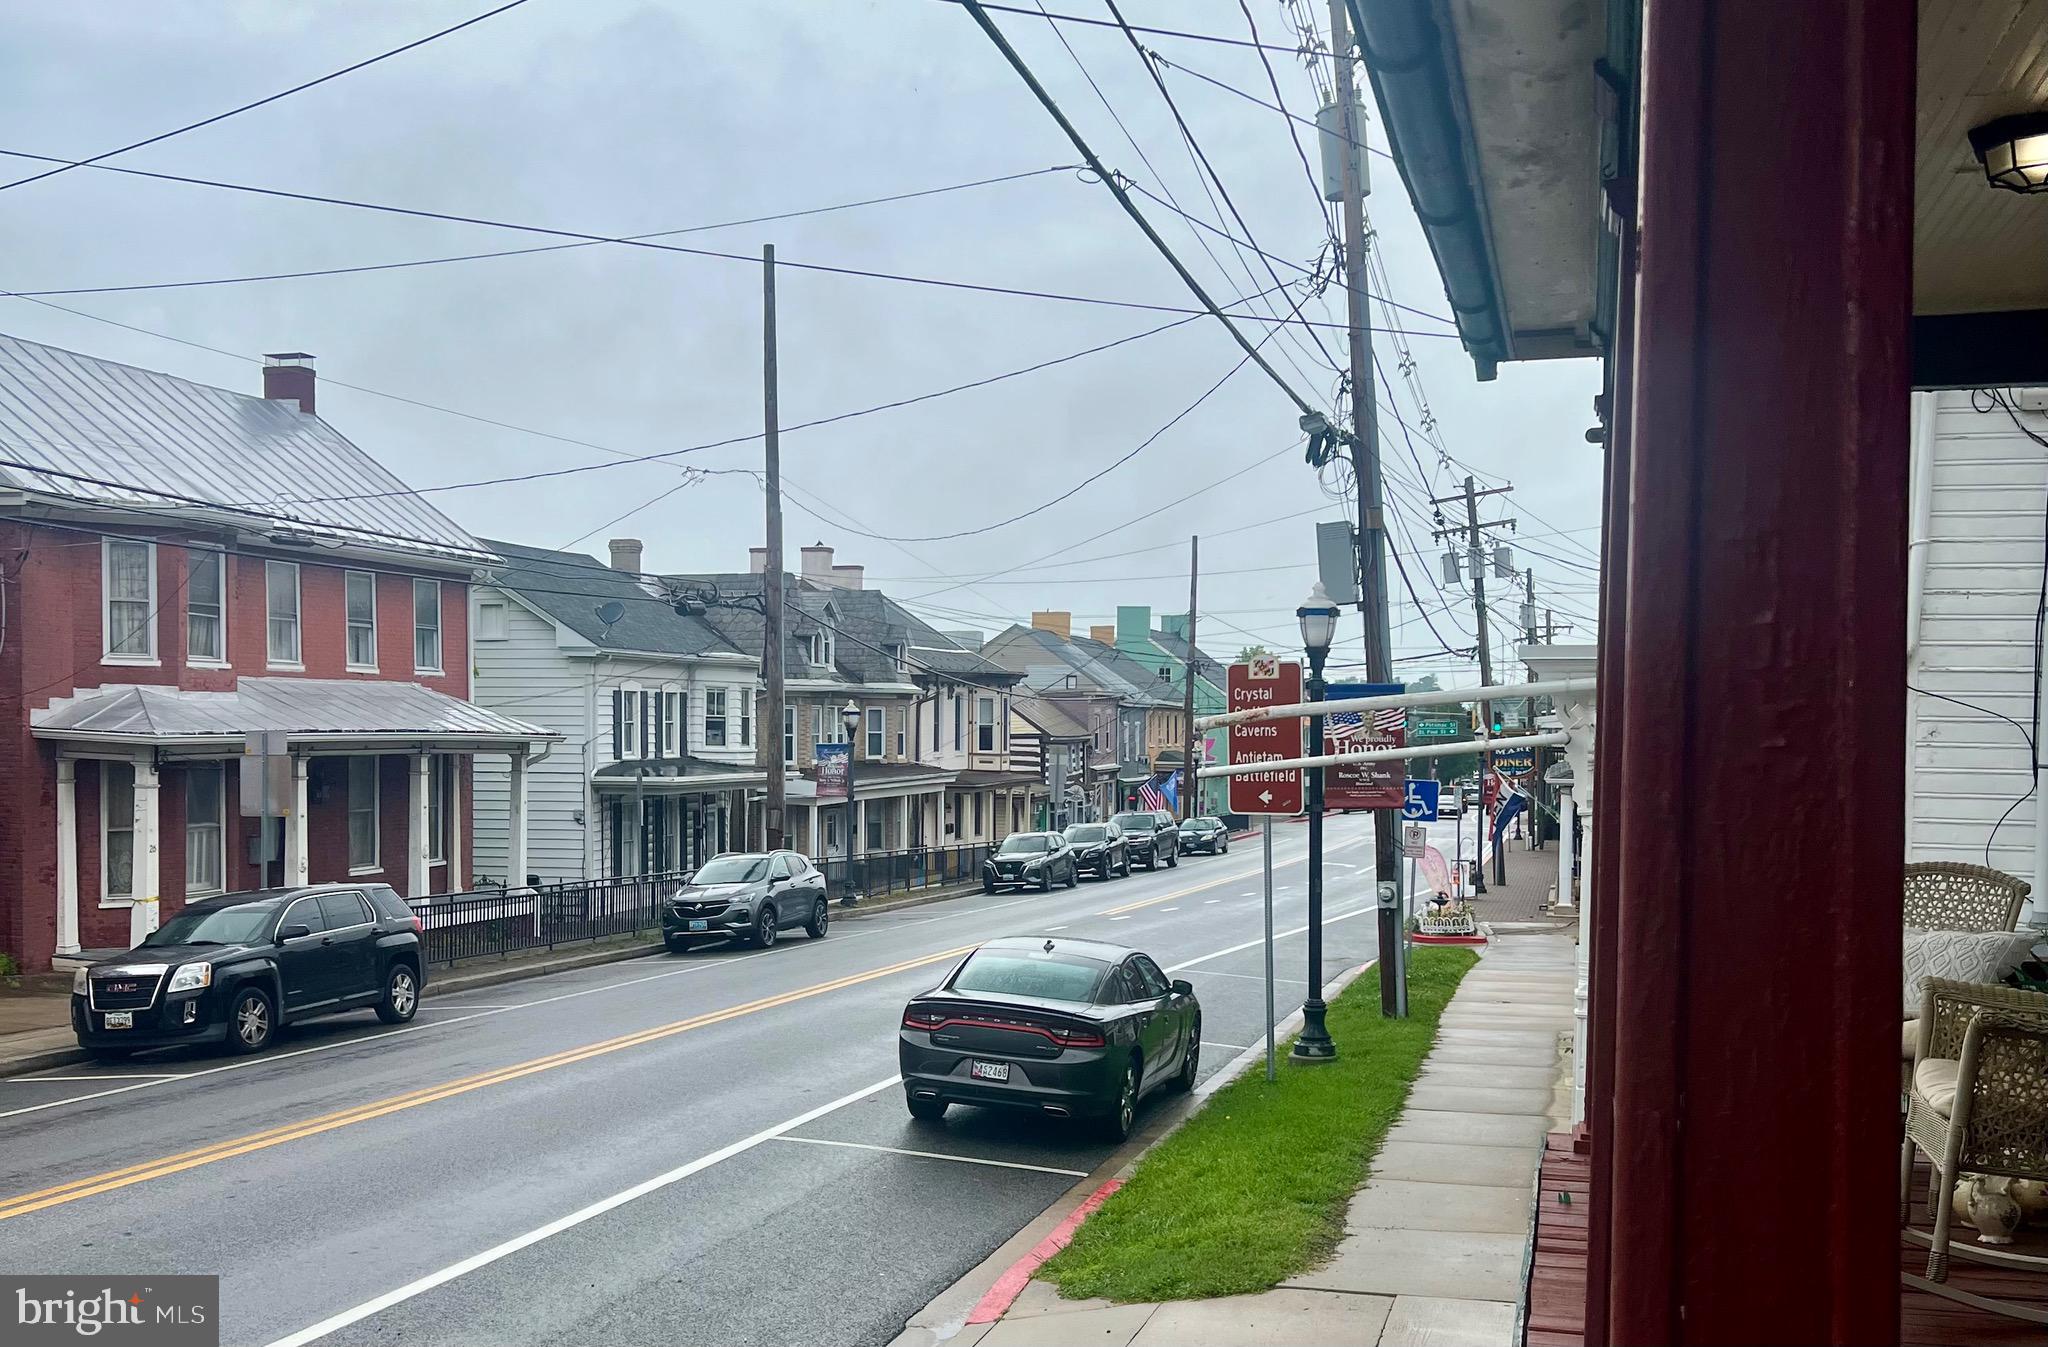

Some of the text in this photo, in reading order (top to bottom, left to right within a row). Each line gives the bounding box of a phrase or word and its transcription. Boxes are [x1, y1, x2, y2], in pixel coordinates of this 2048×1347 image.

[1234, 687, 1273, 702] Crystal
[1235, 725, 1277, 737] Caverns
[1350, 734, 1397, 745] We proudly
[1235, 751, 1284, 764] Antietam
[1495, 758, 1532, 767] DINER
[1236, 770, 1296, 783] Battlefield
[1338, 771, 1360, 779] Roscoe
[1370, 771, 1392, 779] Shank
[106, 983, 137, 993] GMC
